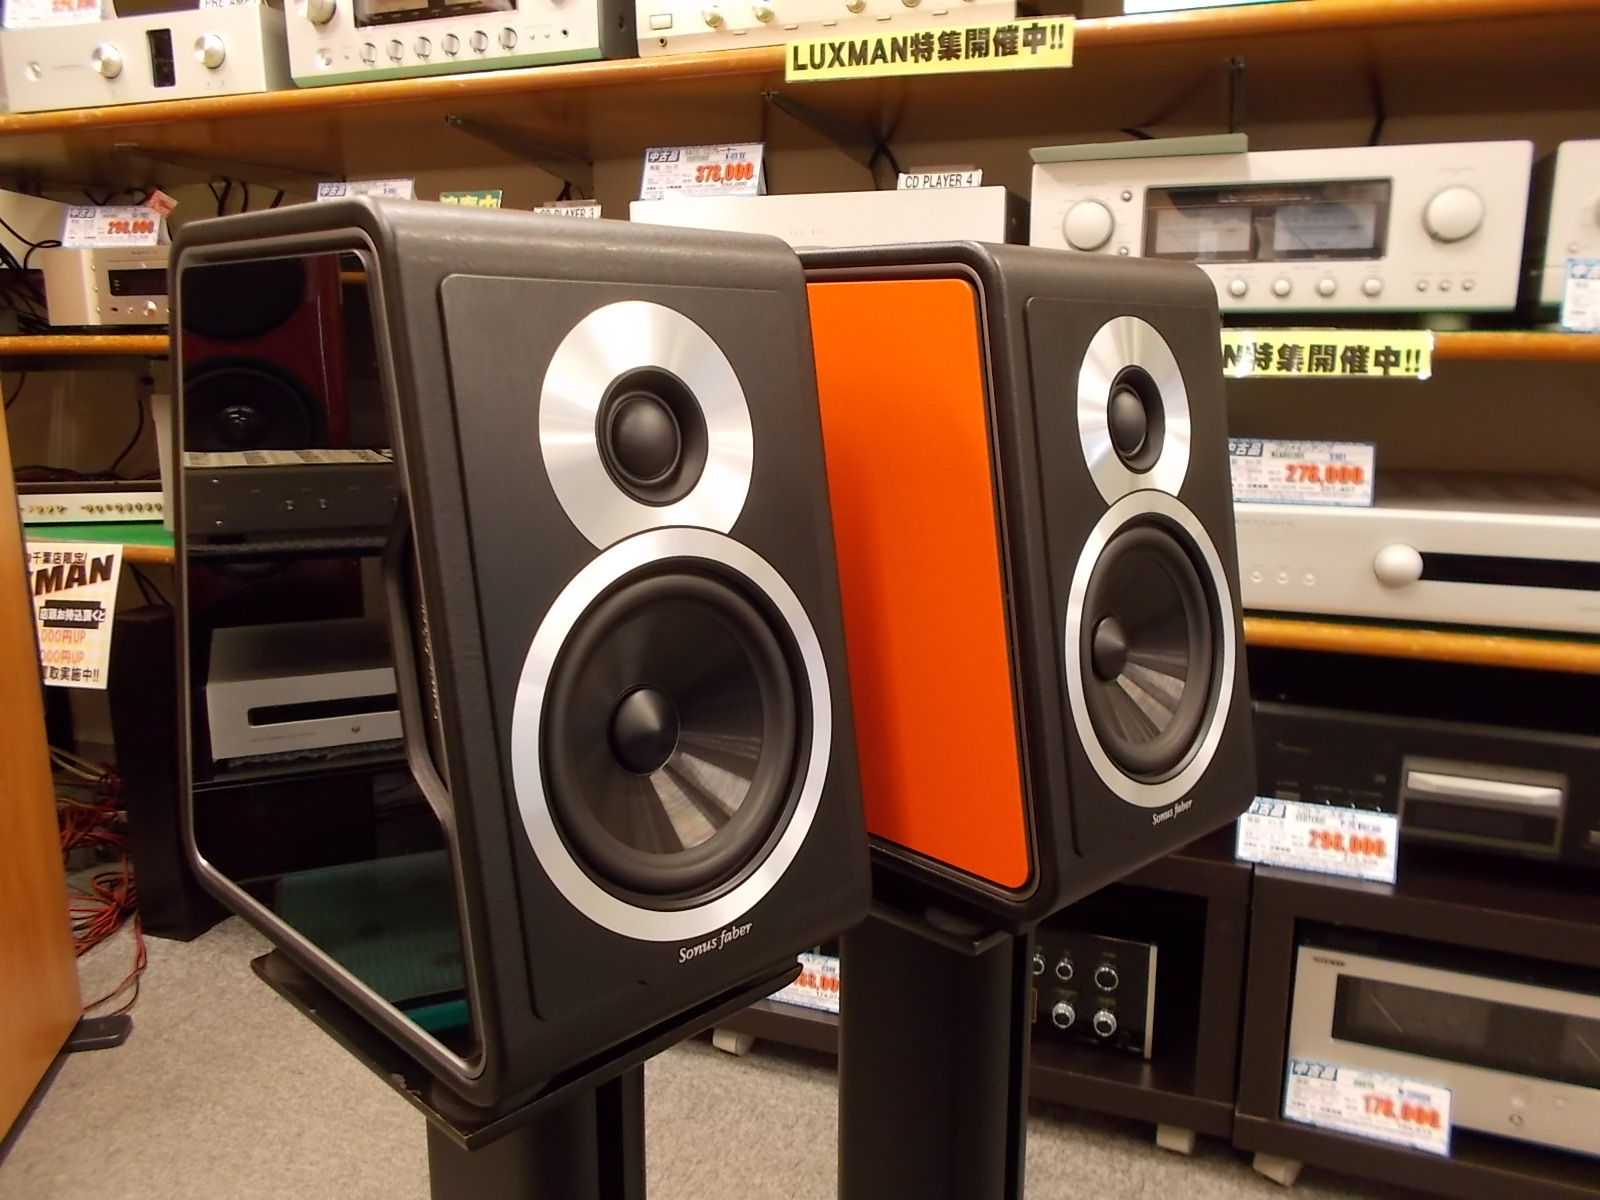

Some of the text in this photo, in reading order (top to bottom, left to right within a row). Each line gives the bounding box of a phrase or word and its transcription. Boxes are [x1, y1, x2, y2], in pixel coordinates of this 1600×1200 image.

[792, 23, 1064, 72] LUXMAN特集開催中!!
[649, 151, 680, 163] 中古品
[695, 162, 754, 183] 378,000
[905, 173, 973, 188] CD PLAYER 4
[1285, 464, 1364, 485] 278,000
[26, 554, 114, 596] MAN
[1152, 808, 1173, 826] Sonus
[678, 922, 753, 963] Sonus faber
